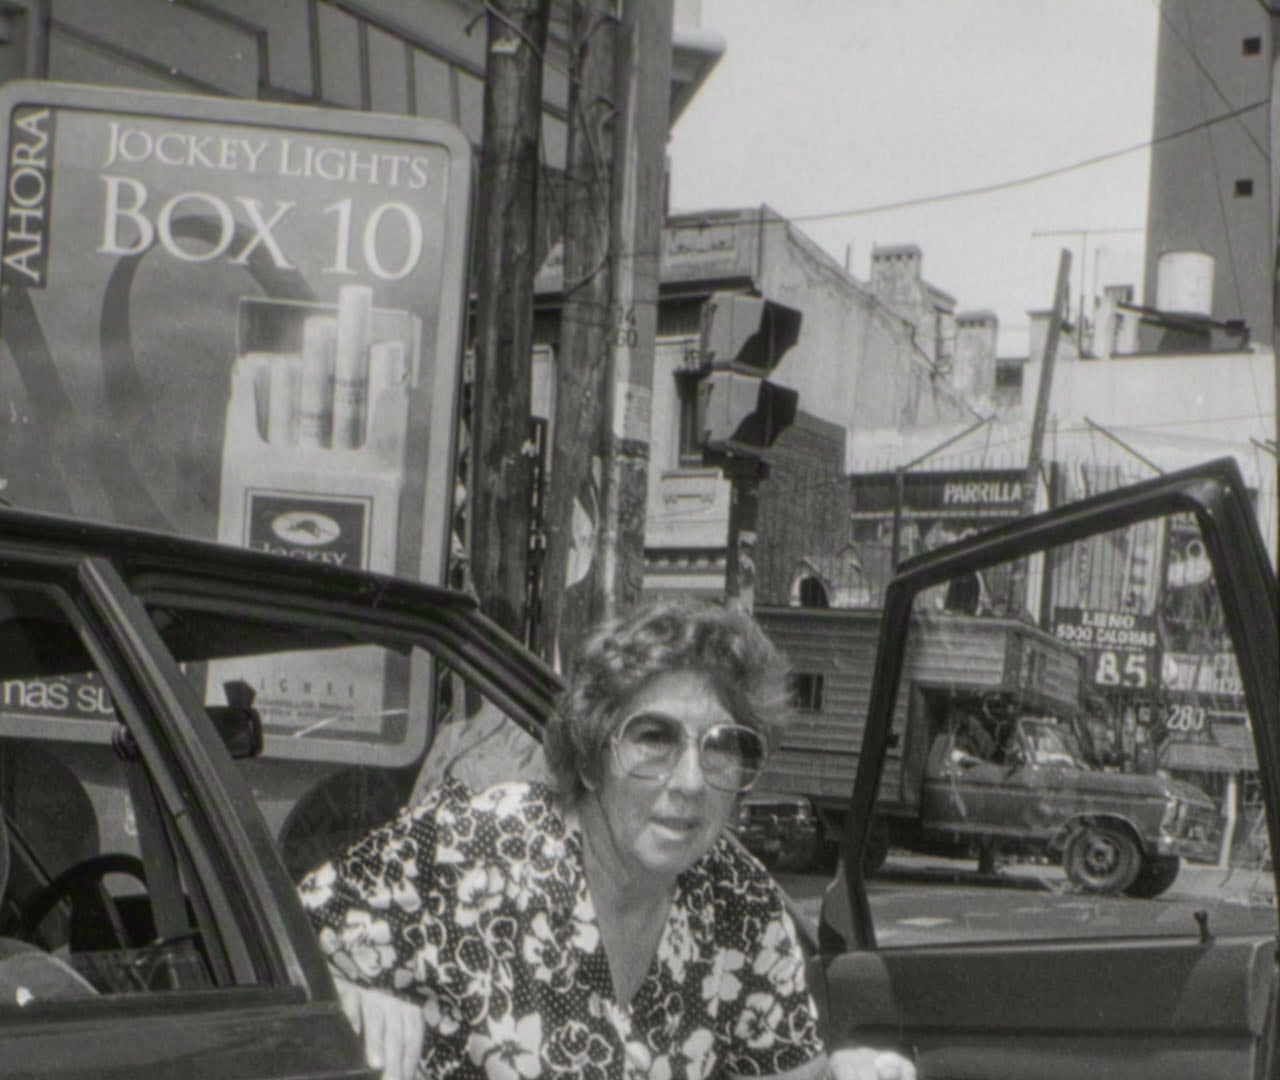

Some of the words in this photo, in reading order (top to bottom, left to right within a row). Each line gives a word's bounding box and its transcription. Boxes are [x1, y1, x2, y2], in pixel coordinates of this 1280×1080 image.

[104, 122, 269, 170] JOCKEY
[280, 138, 429, 190] LIGHTS
[2, 109, 50, 283] AHORA
[96, 174, 298, 271] BOX
[322, 197, 422, 281] 10
[943, 481, 1022, 503] PARRILLA
[1094, 651, 1148, 688] 85
[1166, 703, 1206, 732] 280
